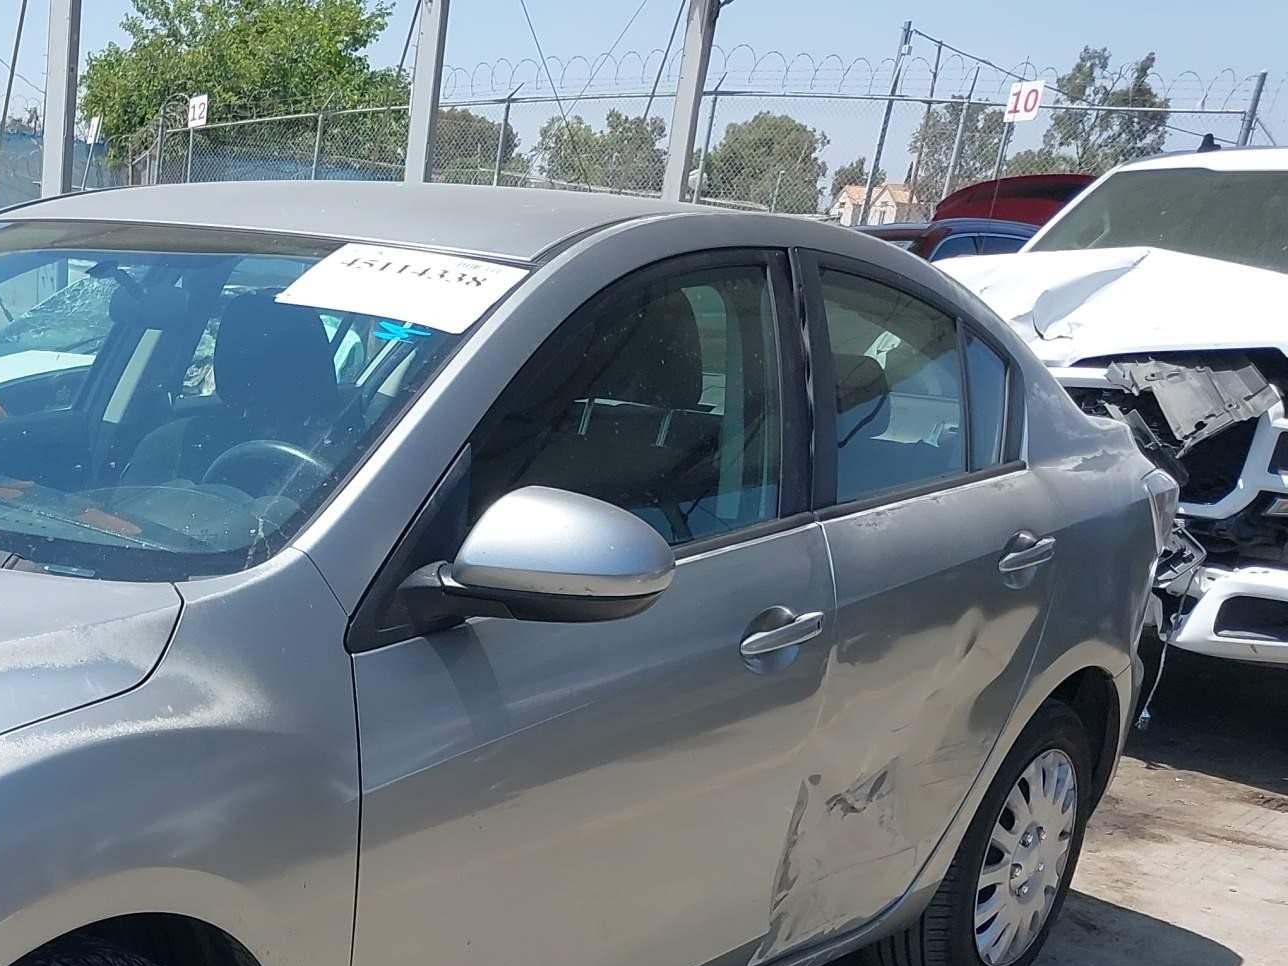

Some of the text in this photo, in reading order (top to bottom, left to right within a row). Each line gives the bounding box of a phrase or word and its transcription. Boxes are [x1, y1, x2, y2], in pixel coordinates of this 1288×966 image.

[189, 102, 206, 122] 12
[1007, 88, 1039, 114] 10
[341, 257, 487, 288] 45114338
